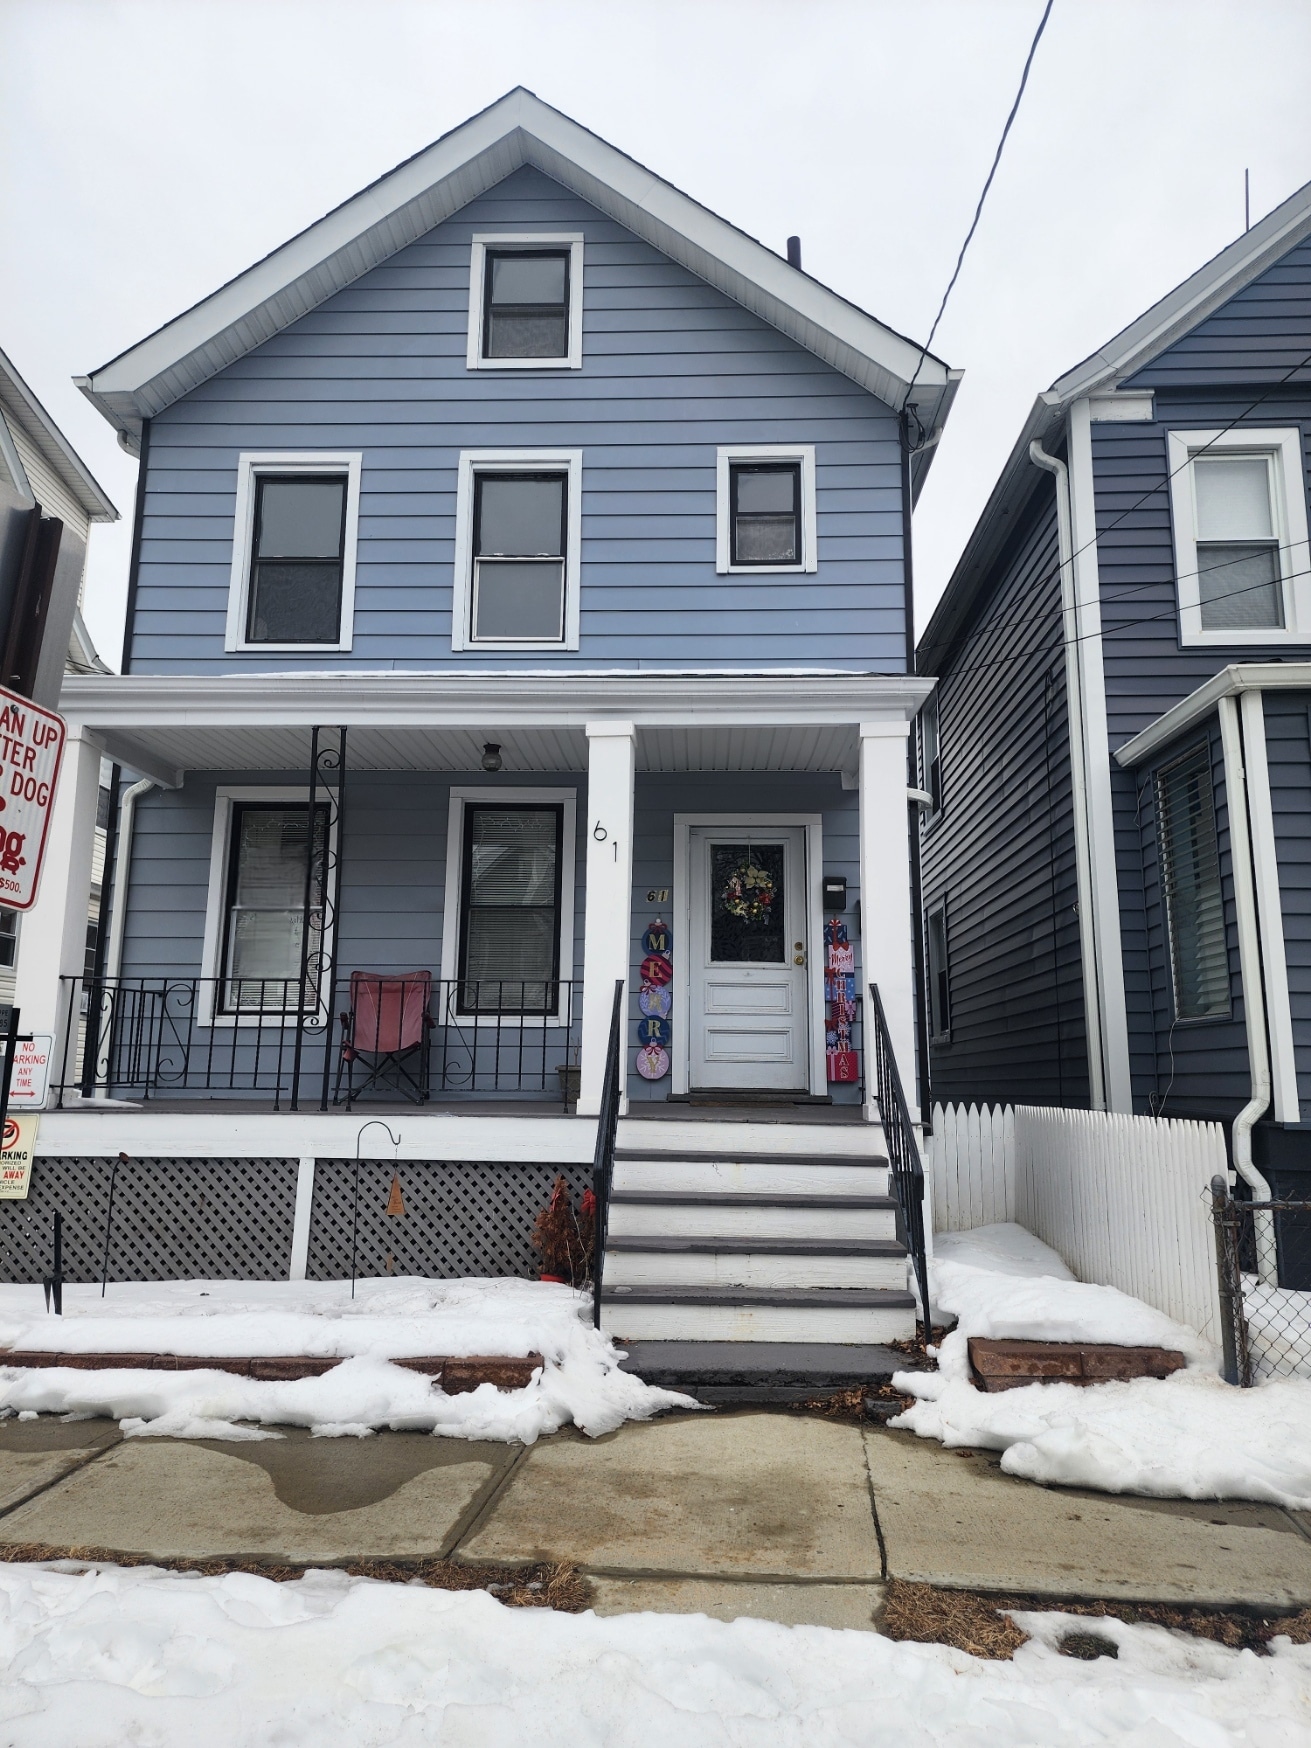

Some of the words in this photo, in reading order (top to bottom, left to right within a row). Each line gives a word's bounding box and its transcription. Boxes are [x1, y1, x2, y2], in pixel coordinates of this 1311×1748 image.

[33, 720, 58, 750] UP
[0, 733, 37, 773] TER
[10, 770, 50, 808] DOG
[593, 820, 618, 863] 61
[646, 889, 669, 903] 61
[829, 952, 853, 967] Merry
[644, 933, 666, 1075] MERRY
[835, 966, 849, 1080] CHRISTMAS
[22, 1042, 36, 1052] NO
[13, 1054, 46, 1065] ARKING
[17, 1067, 33, 1076] ANY
[16, 1078, 32, 1087] TIME
[0, 1151, 28, 1161] RKING
[3, 1170, 25, 1180] AWAY
